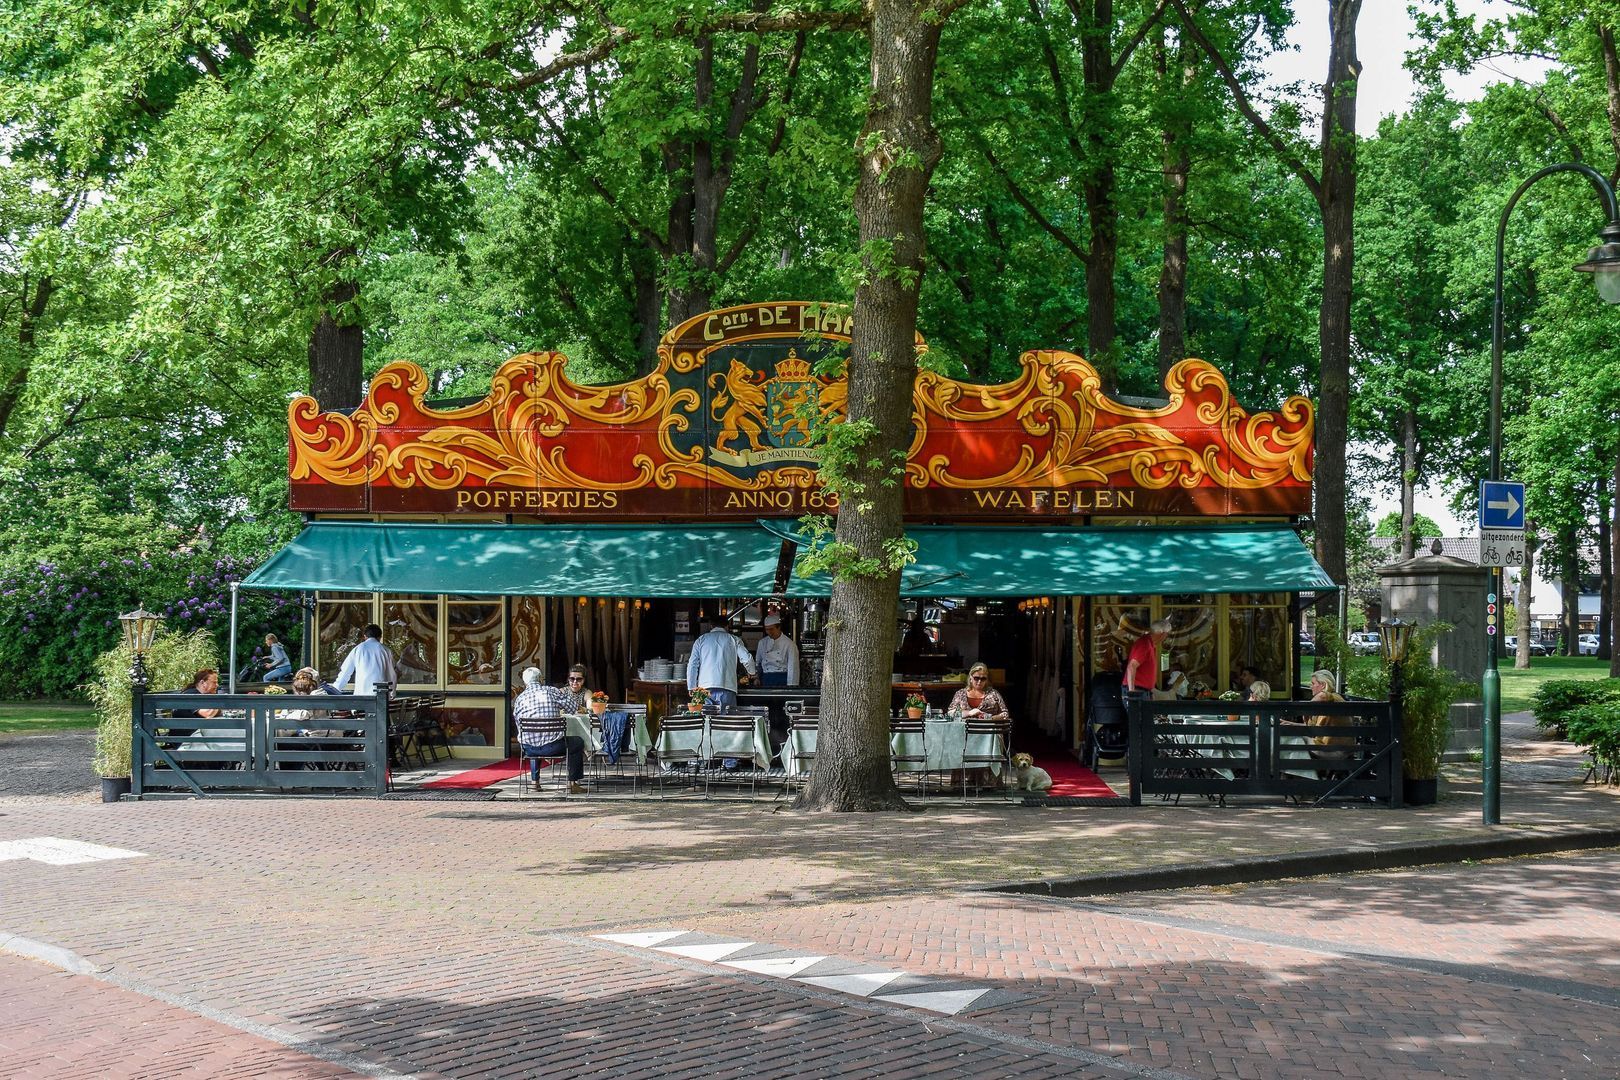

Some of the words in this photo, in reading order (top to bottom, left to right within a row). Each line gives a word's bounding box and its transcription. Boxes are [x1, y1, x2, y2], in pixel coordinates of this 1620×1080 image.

[759, 306, 791, 325] DE
[756, 454, 766, 462] JE
[457, 490, 618, 508] POFFERTJES
[724, 490, 792, 508] ANNO
[801, 491, 840, 508] 183
[973, 490, 1134, 508] WAFELEN
[1481, 533, 1524, 543] uitgezonderd
